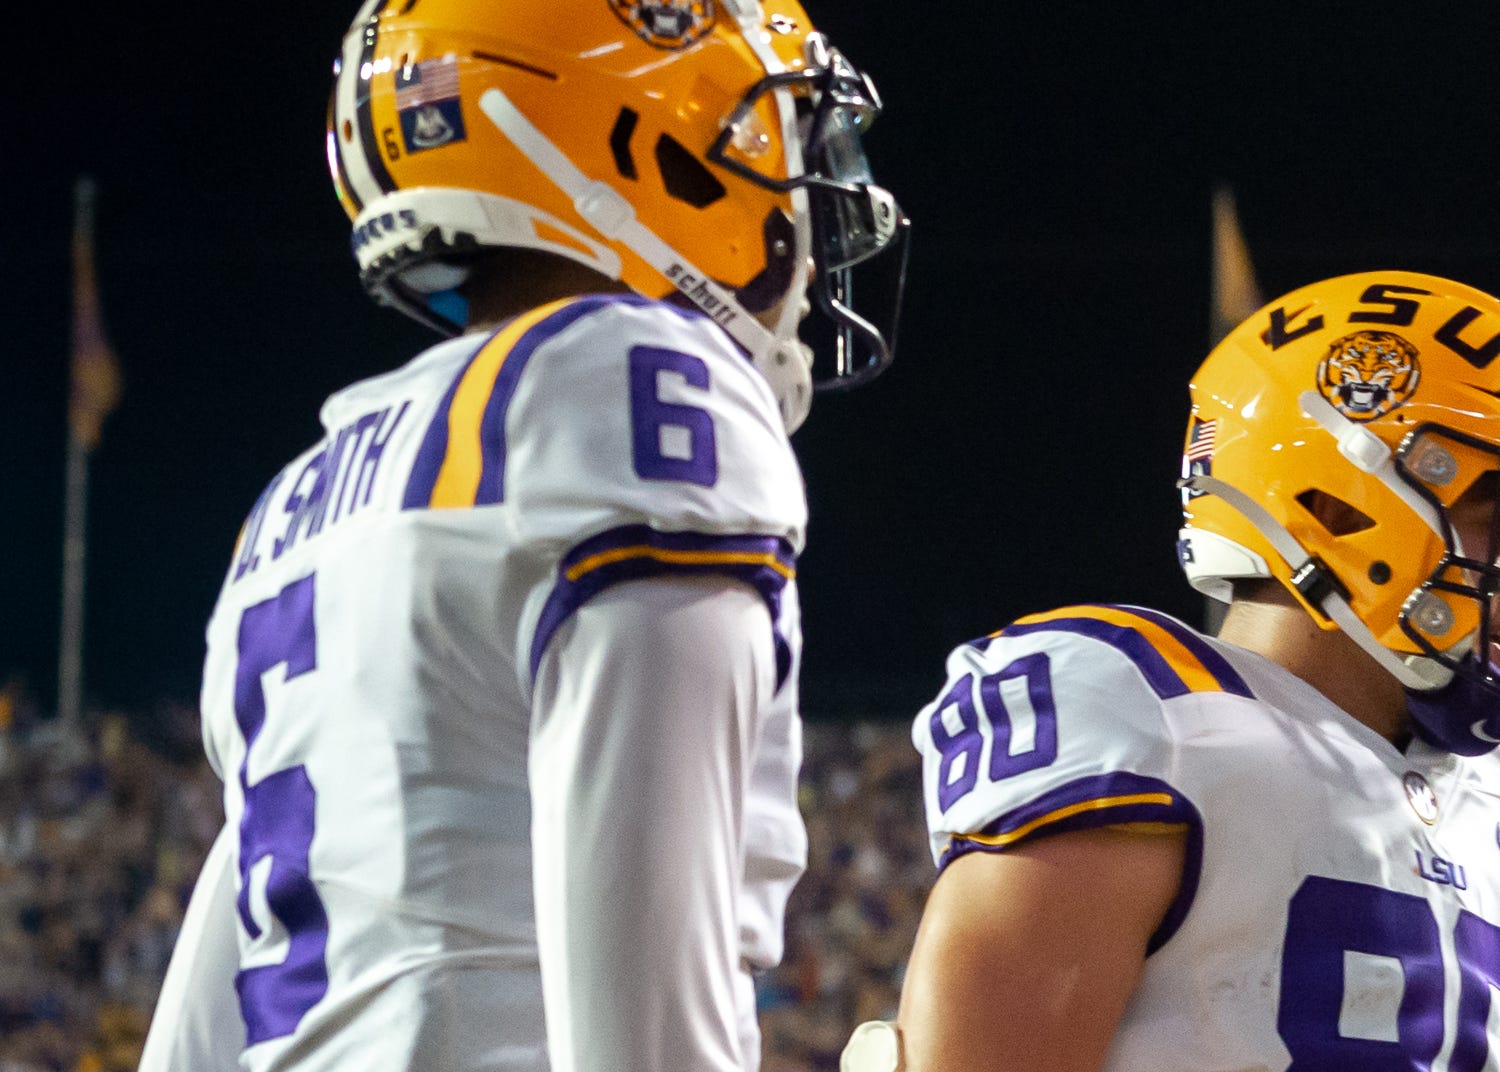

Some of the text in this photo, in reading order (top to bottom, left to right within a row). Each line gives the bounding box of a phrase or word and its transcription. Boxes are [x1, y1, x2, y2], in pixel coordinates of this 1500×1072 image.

[271, 399, 413, 561] SMITH
[629, 343, 719, 488] 6
[233, 570, 329, 1050] 6
[929, 652, 1059, 816] 80
[1415, 849, 1468, 891] LSU
